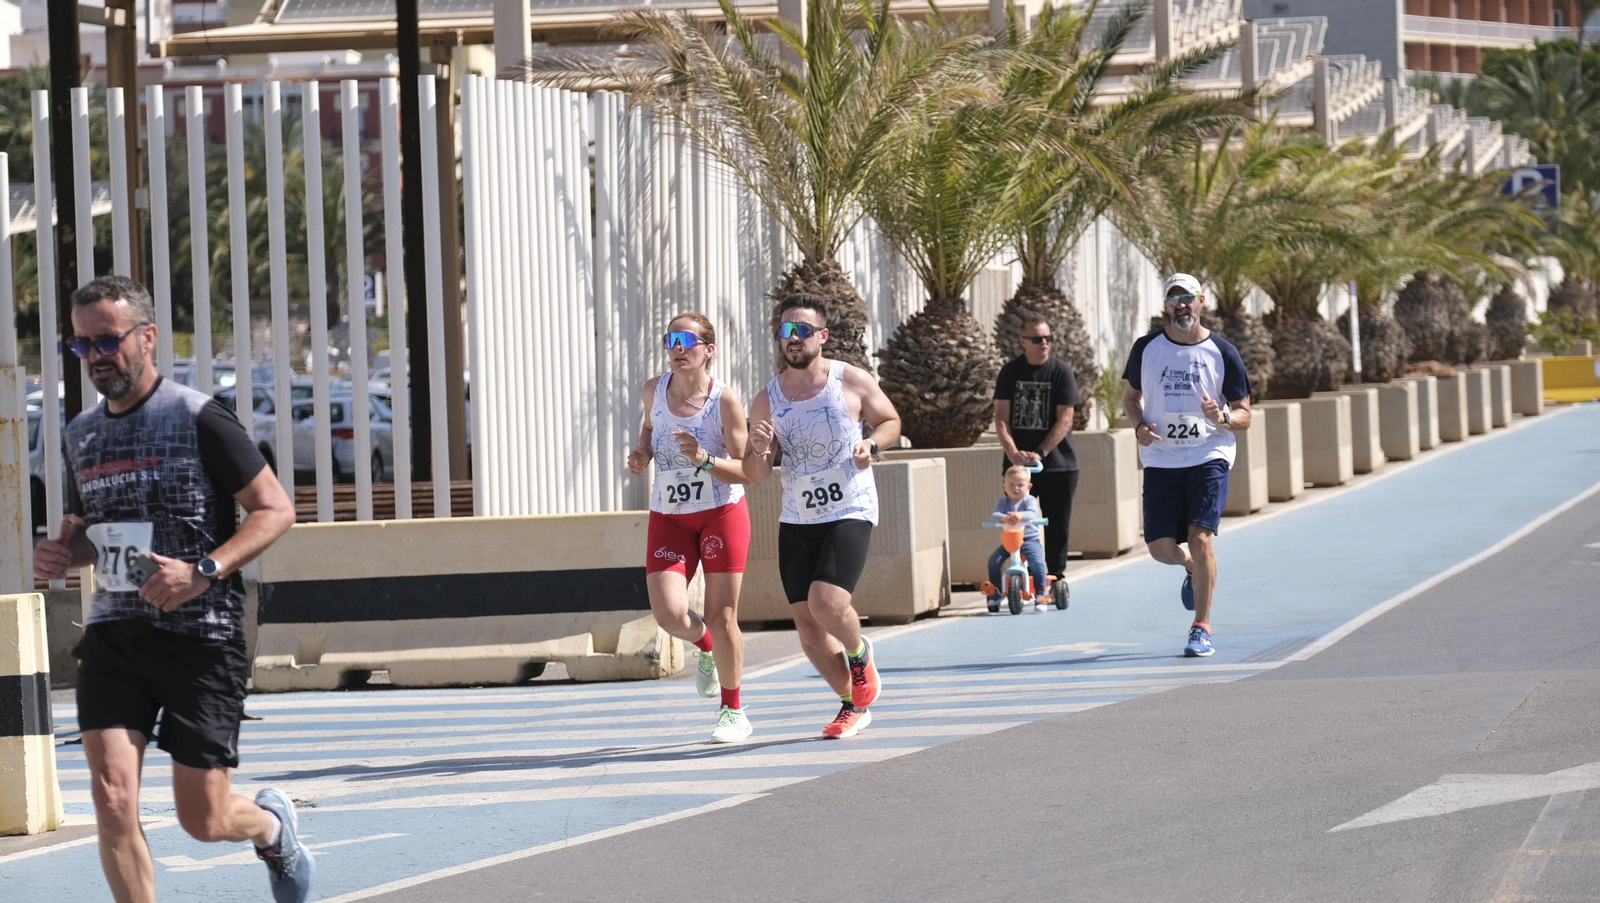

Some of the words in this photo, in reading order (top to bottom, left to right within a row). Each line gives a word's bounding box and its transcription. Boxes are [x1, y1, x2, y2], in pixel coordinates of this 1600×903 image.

[1167, 423, 1200, 439] 224
[81, 472, 136, 493] ANDALUCIA
[666, 481, 704, 503] 297
[801, 482, 844, 509] 298
